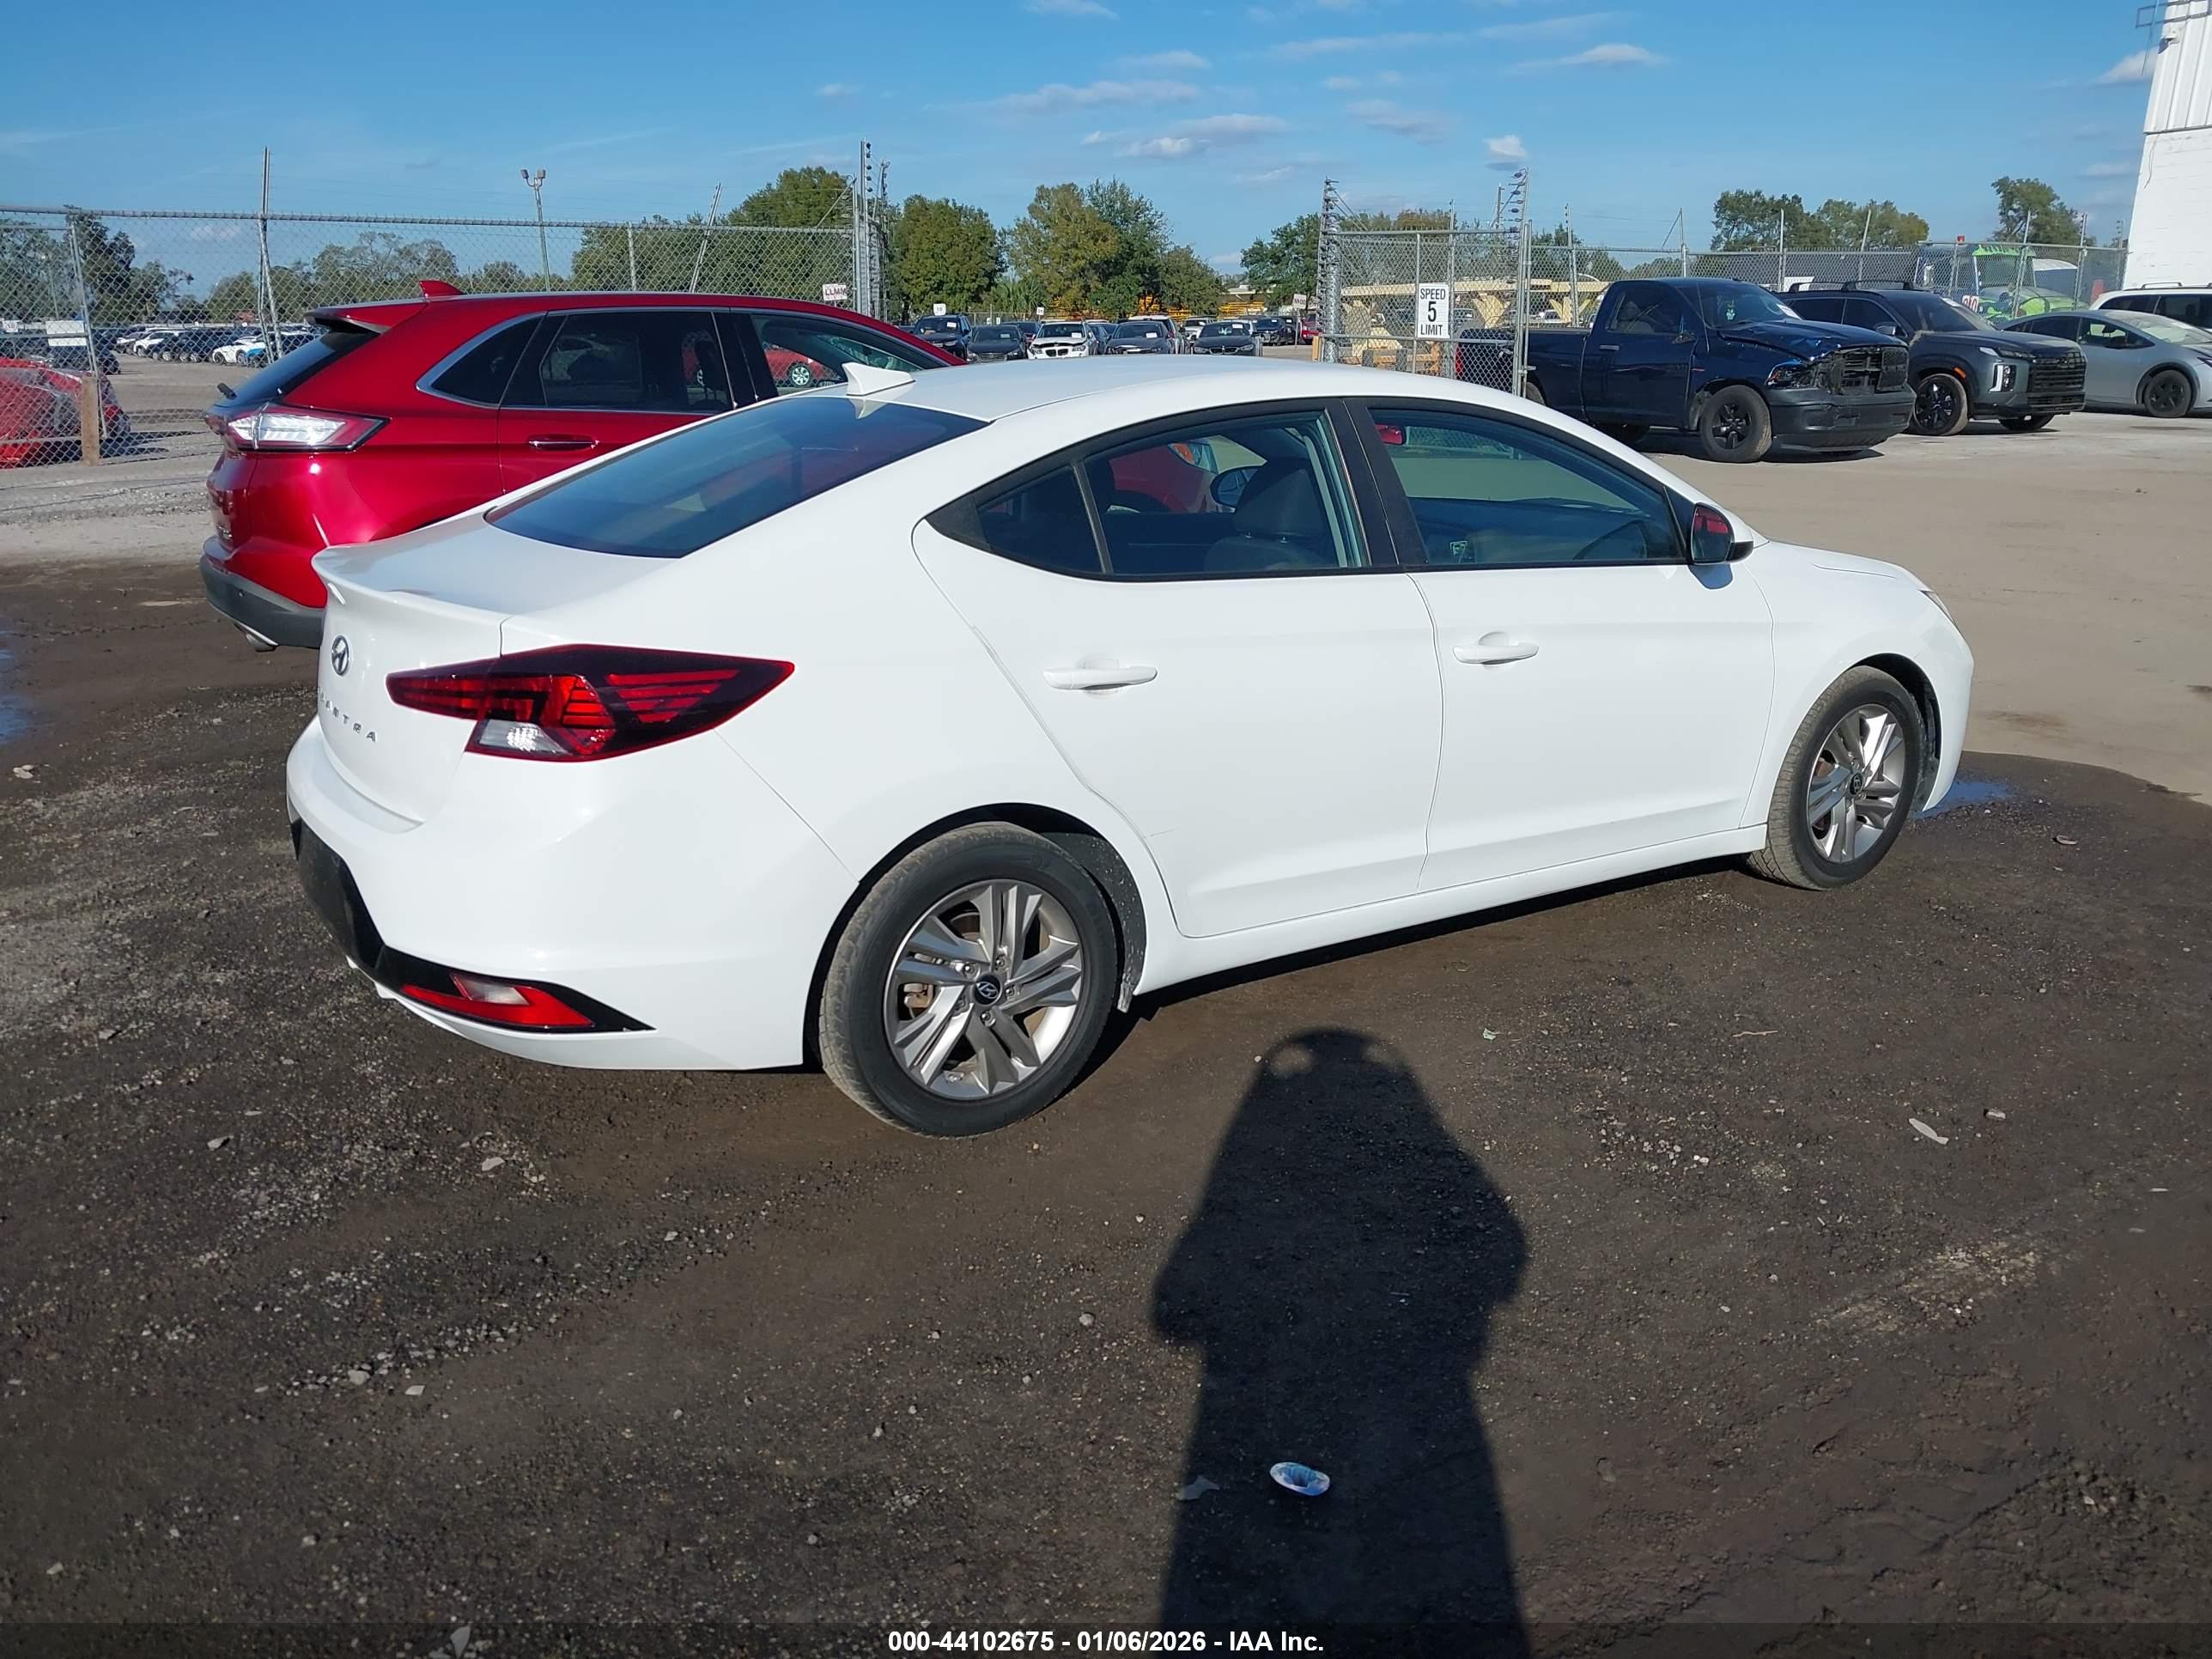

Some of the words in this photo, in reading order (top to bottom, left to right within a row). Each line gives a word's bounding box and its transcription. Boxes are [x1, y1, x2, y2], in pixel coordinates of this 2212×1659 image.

[1419, 288, 1446, 300] SPEED
[1427, 301, 1437, 322] 5
[1420, 324, 1443, 336] LIMIT
